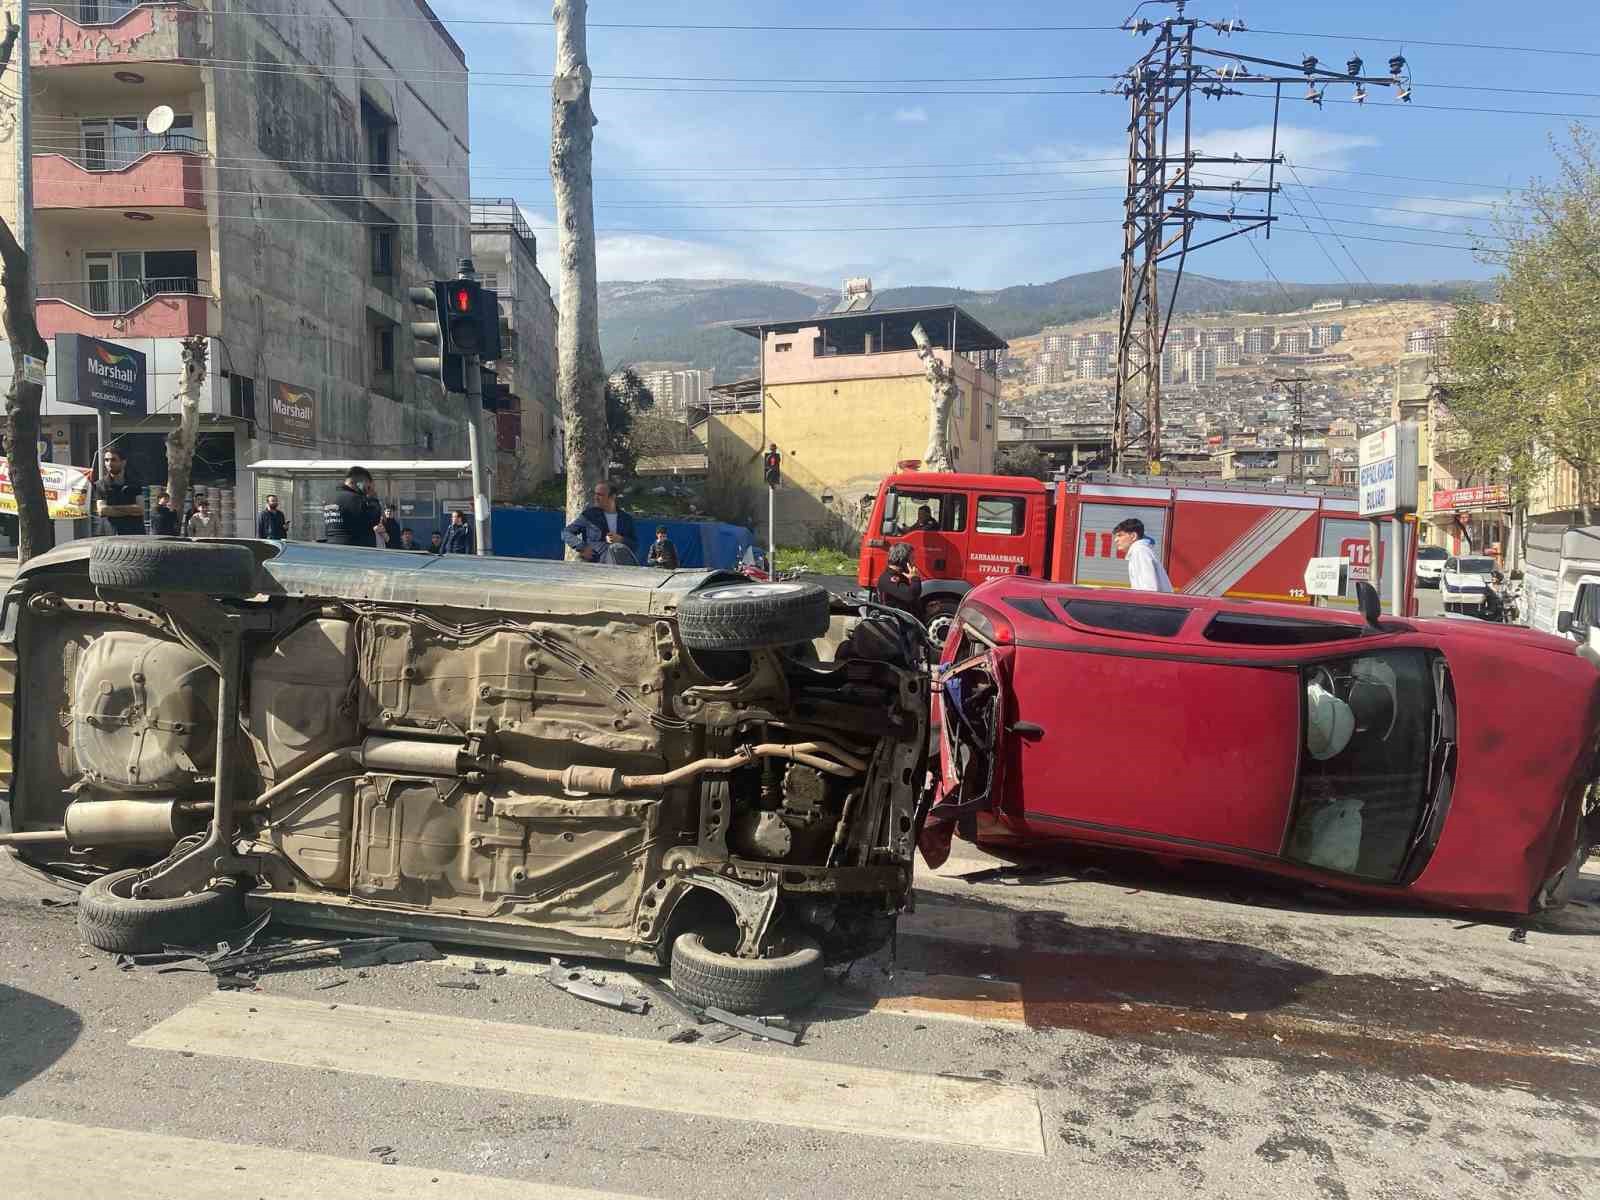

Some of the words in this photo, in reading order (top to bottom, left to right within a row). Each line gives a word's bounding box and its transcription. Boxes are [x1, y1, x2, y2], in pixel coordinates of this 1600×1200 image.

[87, 357, 133, 383] Marshall
[272, 398, 310, 420] Marshall
[1289, 588, 1305, 598] 112
